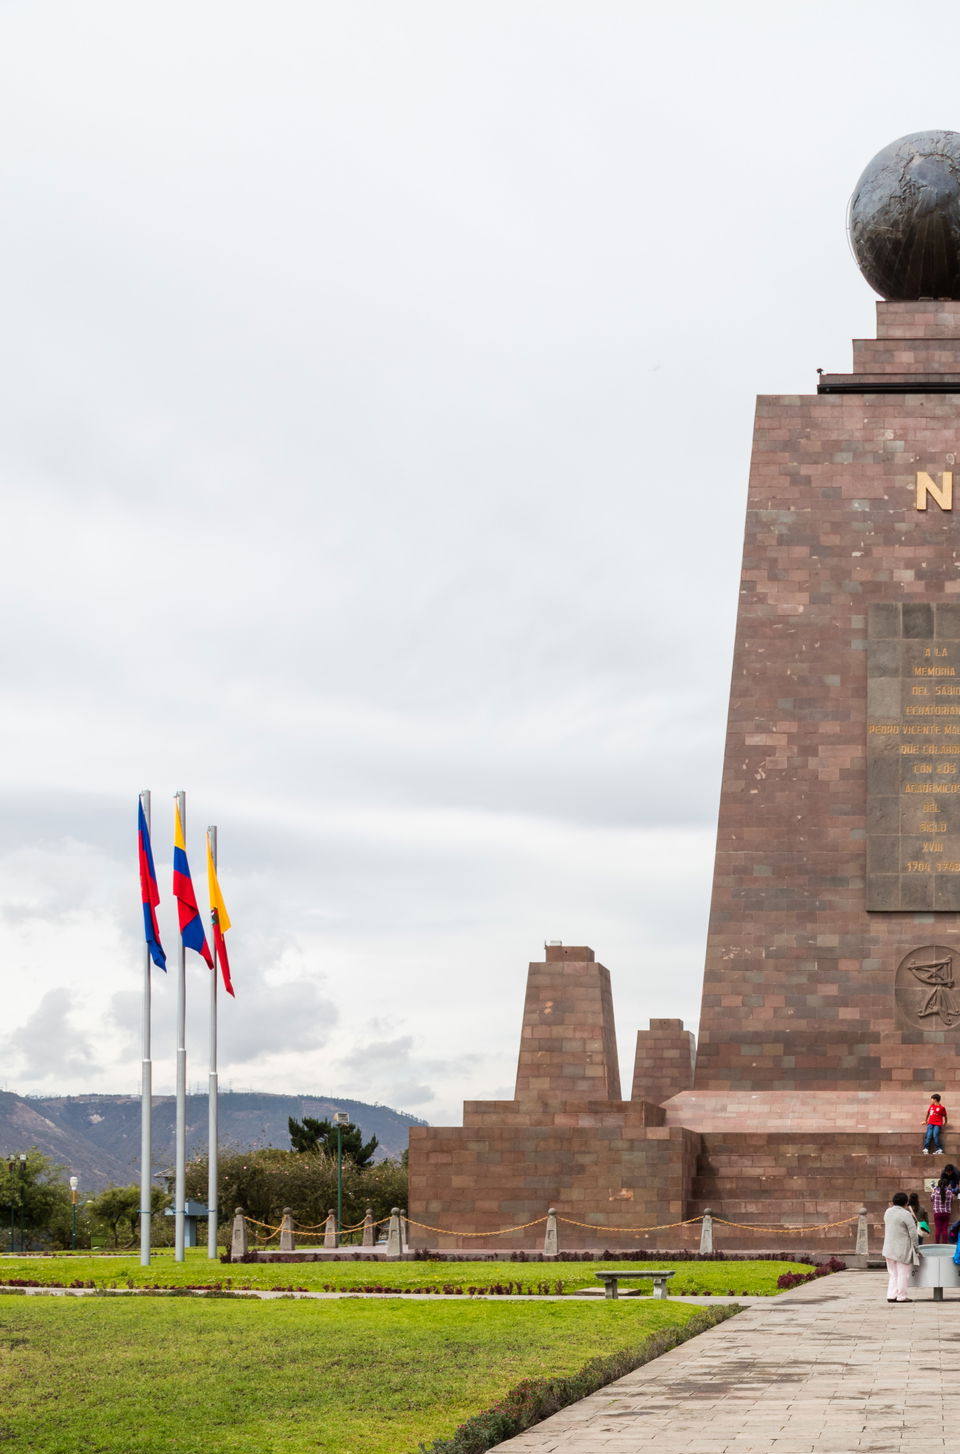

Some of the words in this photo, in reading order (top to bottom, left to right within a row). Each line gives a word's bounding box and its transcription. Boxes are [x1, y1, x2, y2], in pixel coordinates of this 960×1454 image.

[917, 472, 953, 510] N
[924, 648, 931, 656] A
[934, 648, 948, 656] LA
[913, 667, 956, 676] MEMORIA
[912, 686, 928, 695] DEL
[936, 686, 960, 695] SABIO
[868, 725, 899, 734] PEDRO
[903, 725, 940, 734] VICENTE
[901, 745, 918, 754] QUE
[913, 763, 931, 773] CON
[937, 763, 956, 773] LOS
[923, 802, 940, 812] DEL
[920, 823, 947, 832] SIGLO
[922, 843, 943, 852] XVIII
[906, 862, 930, 871] 1704
